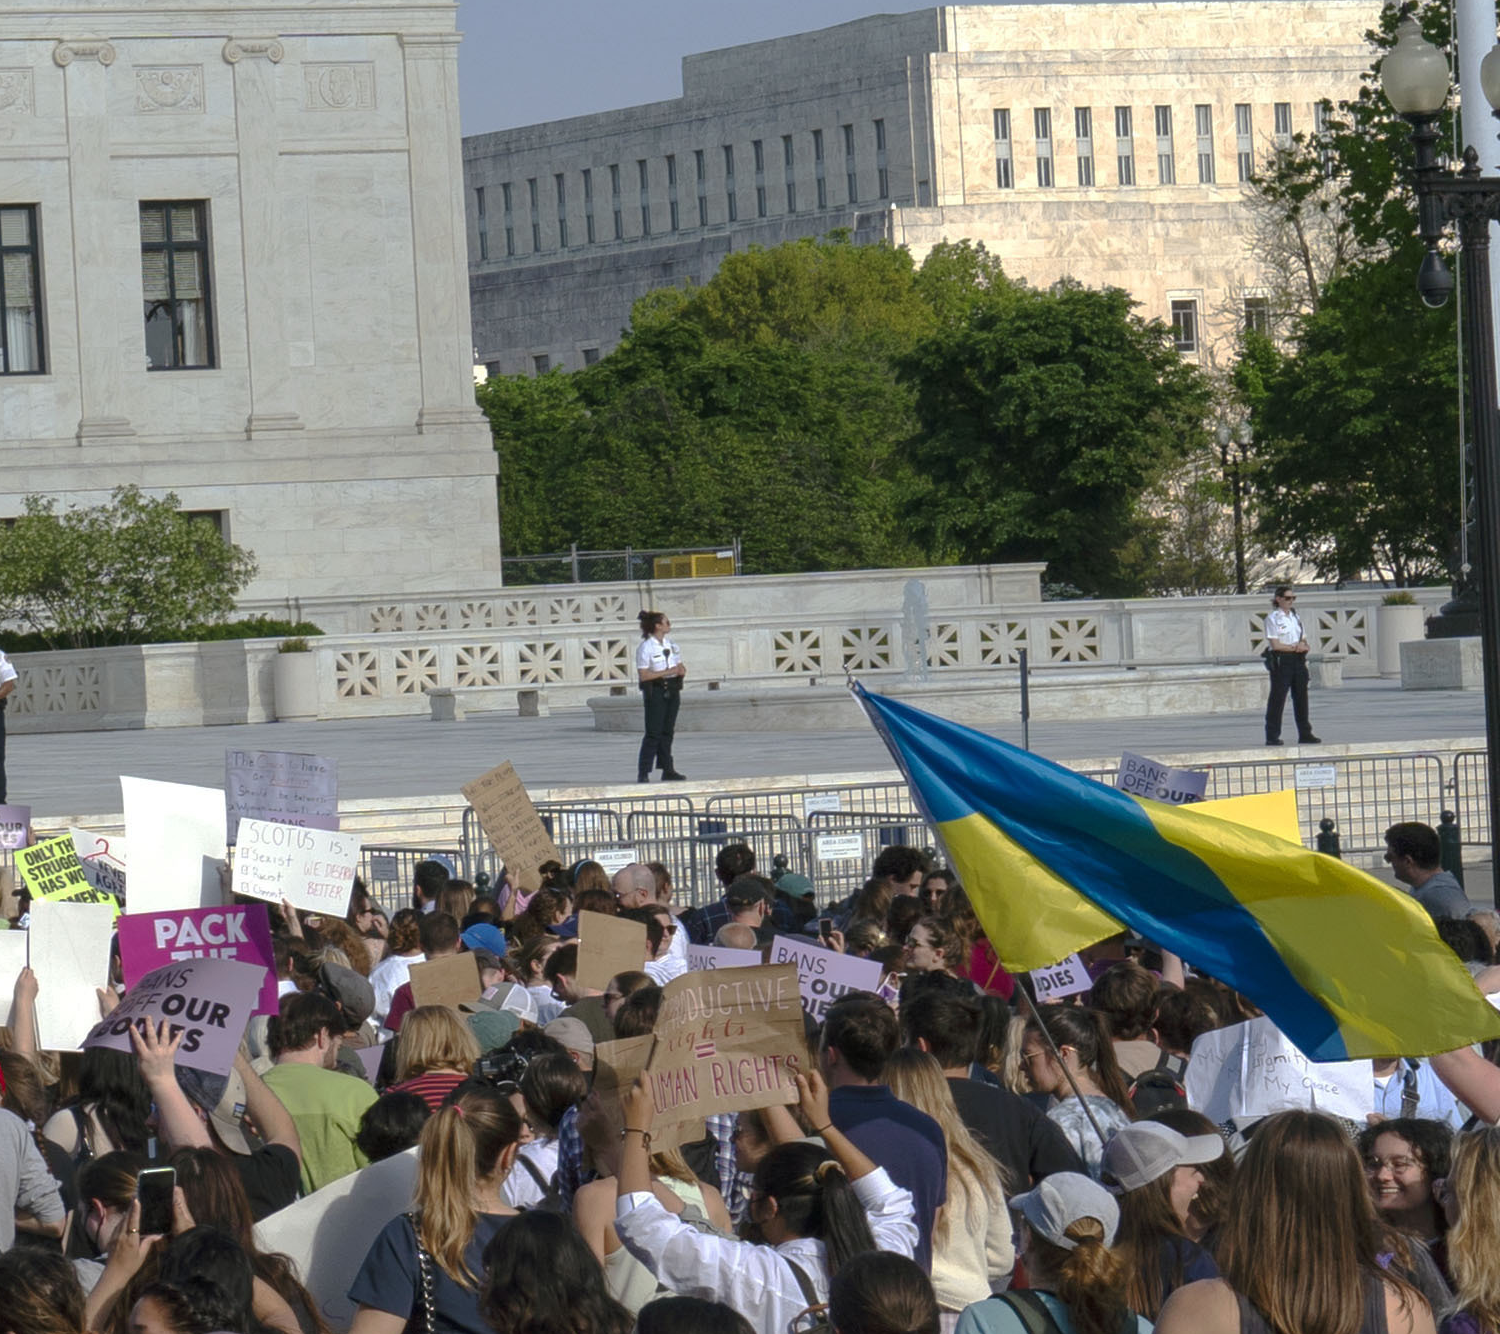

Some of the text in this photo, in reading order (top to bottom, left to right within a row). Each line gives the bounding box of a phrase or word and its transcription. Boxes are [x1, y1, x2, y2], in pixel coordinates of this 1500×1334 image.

[1123, 773, 1156, 795] OFF
[1125, 759, 1168, 785] BANS
[250, 824, 315, 851] SCOTUS
[23, 847, 56, 866] ONLY
[304, 862, 321, 877] WE
[38, 875, 66, 895] HAS
[306, 882, 343, 900] BETTER
[154, 913, 248, 949] PACK
[777, 947, 827, 974] BANS
[161, 994, 230, 1028] OUR
[667, 1018, 746, 1052] rights
[711, 1053, 800, 1097] RIGHTS
[1264, 1077, 1290, 1095] My
